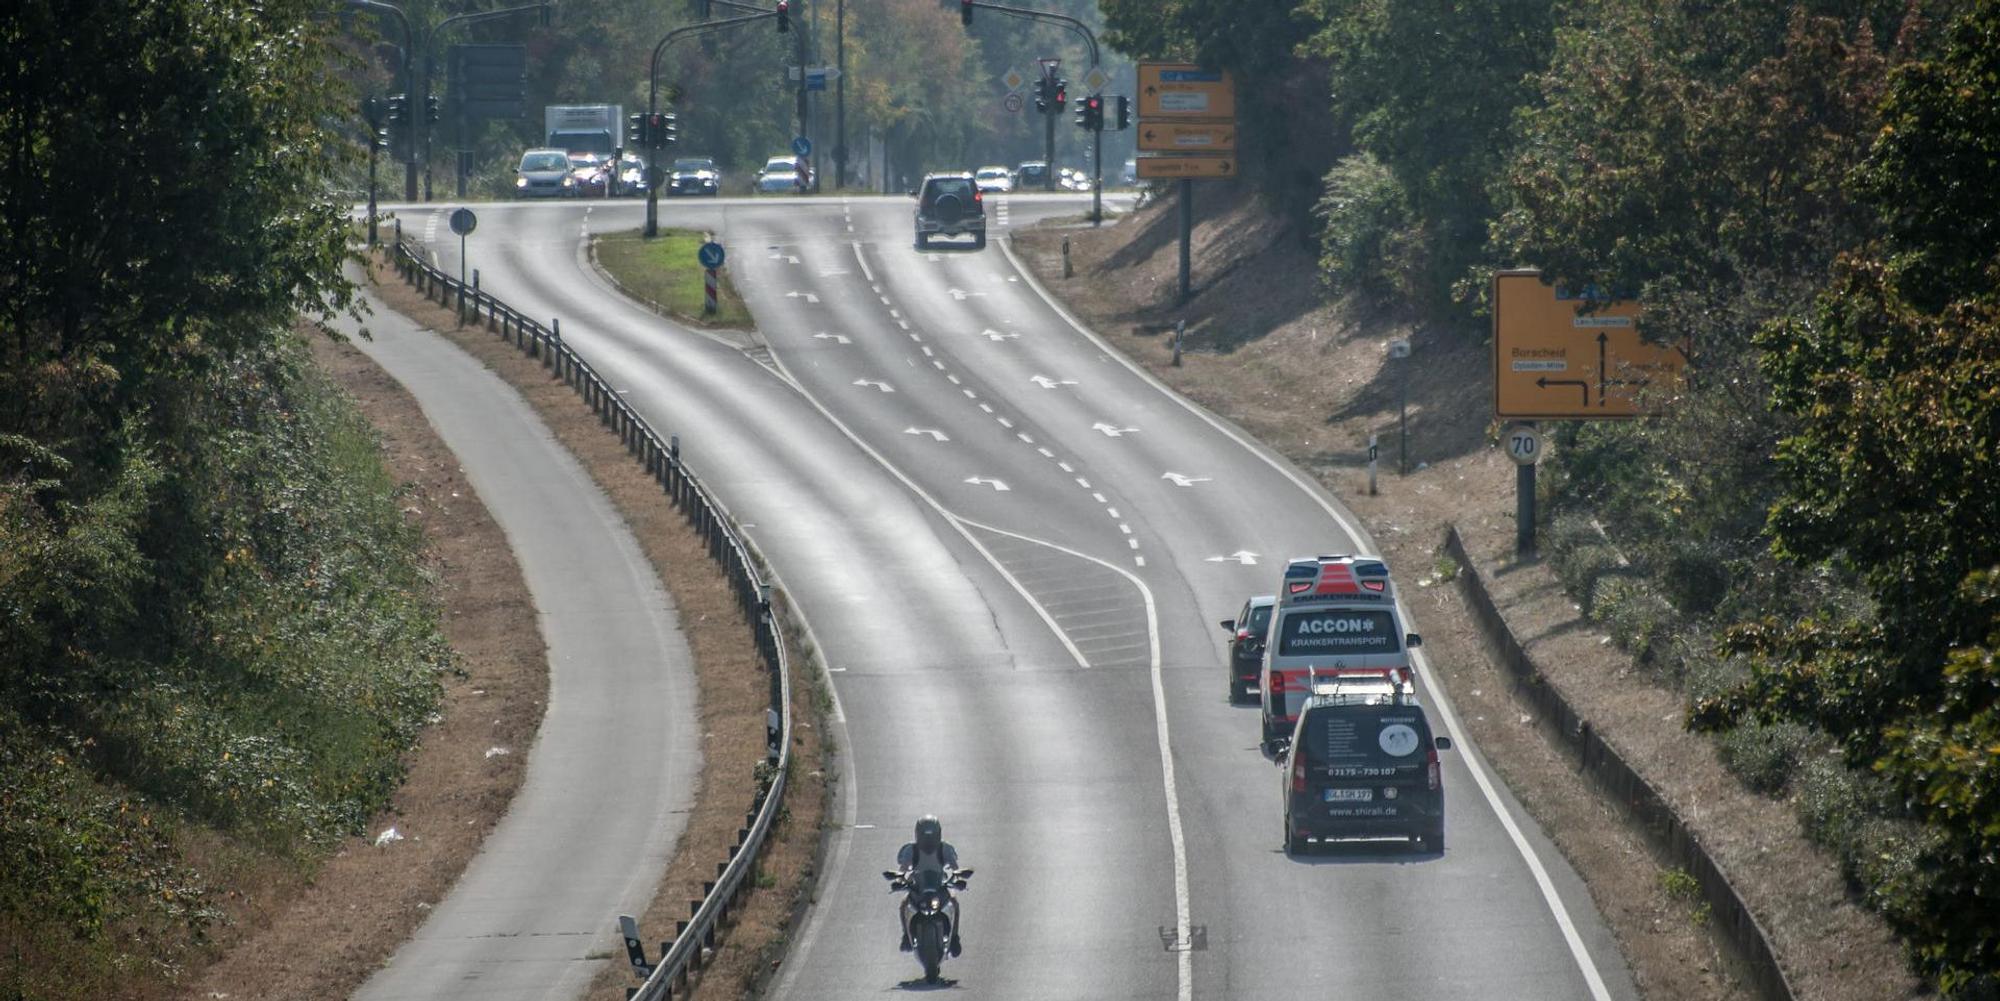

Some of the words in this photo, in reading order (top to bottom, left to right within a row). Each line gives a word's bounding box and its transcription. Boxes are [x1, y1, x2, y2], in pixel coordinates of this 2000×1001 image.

[1512, 436, 1534, 454] 70
[1293, 594, 1382, 602] KRANKENWAGEN
[1298, 618, 1361, 634] ACCON
[1291, 637, 1387, 647] KRANKENTRANSPORT
[1364, 768, 1380, 776] 730
[1381, 767, 1396, 775] 107
[1329, 806, 1397, 816] www.shirali.de
